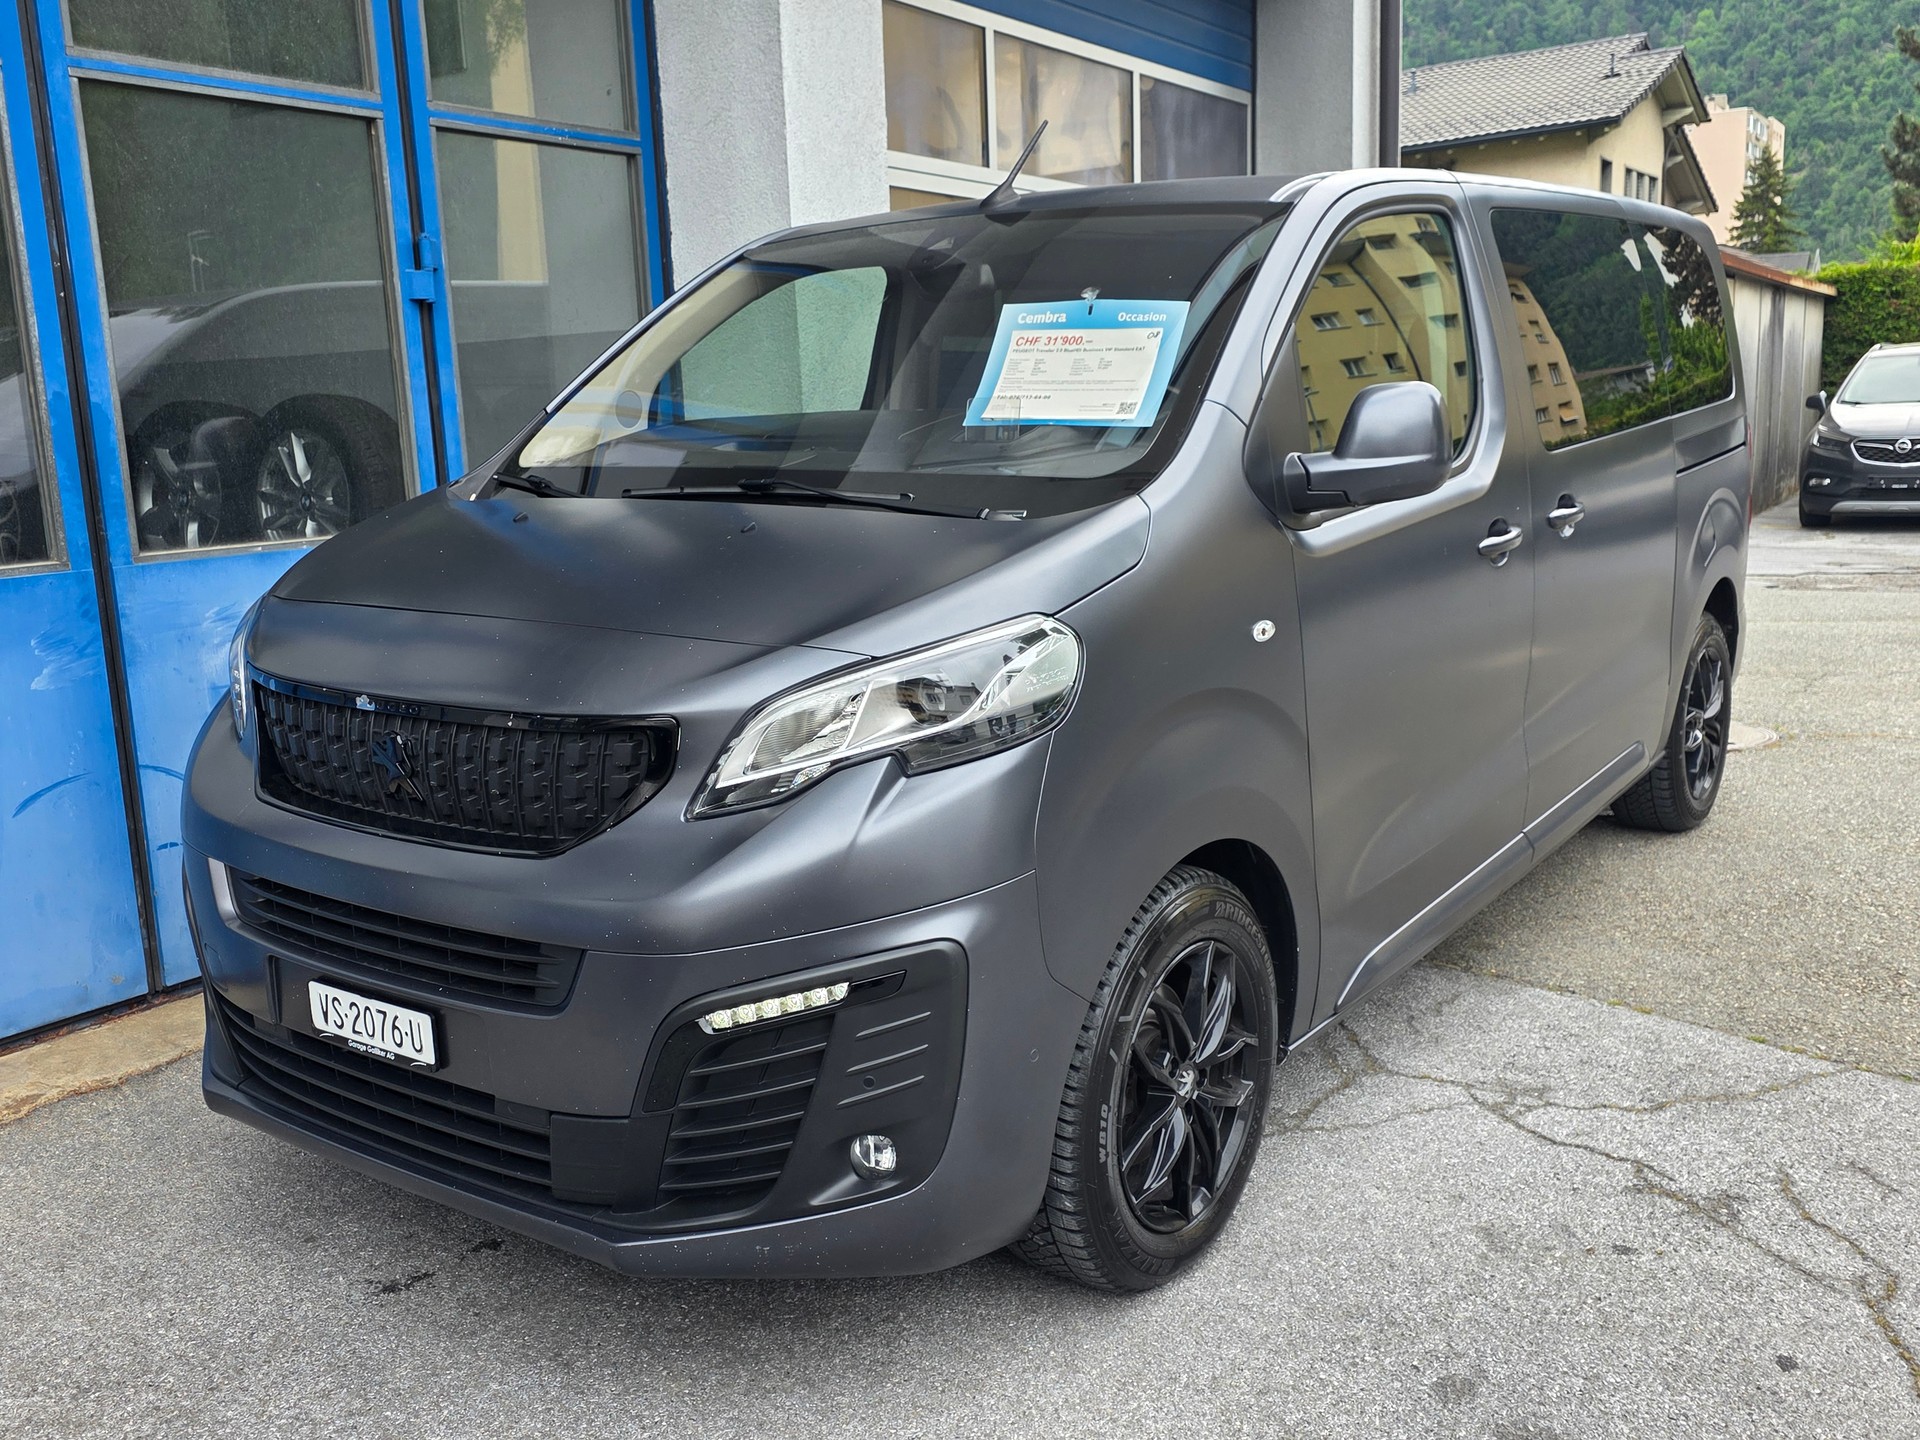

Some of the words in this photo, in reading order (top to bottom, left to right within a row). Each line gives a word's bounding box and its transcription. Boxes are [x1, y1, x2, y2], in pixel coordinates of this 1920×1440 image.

[1016, 311, 1067, 325] Cembra
[1117, 311, 1167, 322] Occasion
[1016, 336, 1042, 347] CHF
[347, 1039, 367, 1052] Garage
[386, 1051, 396, 1061] AG
